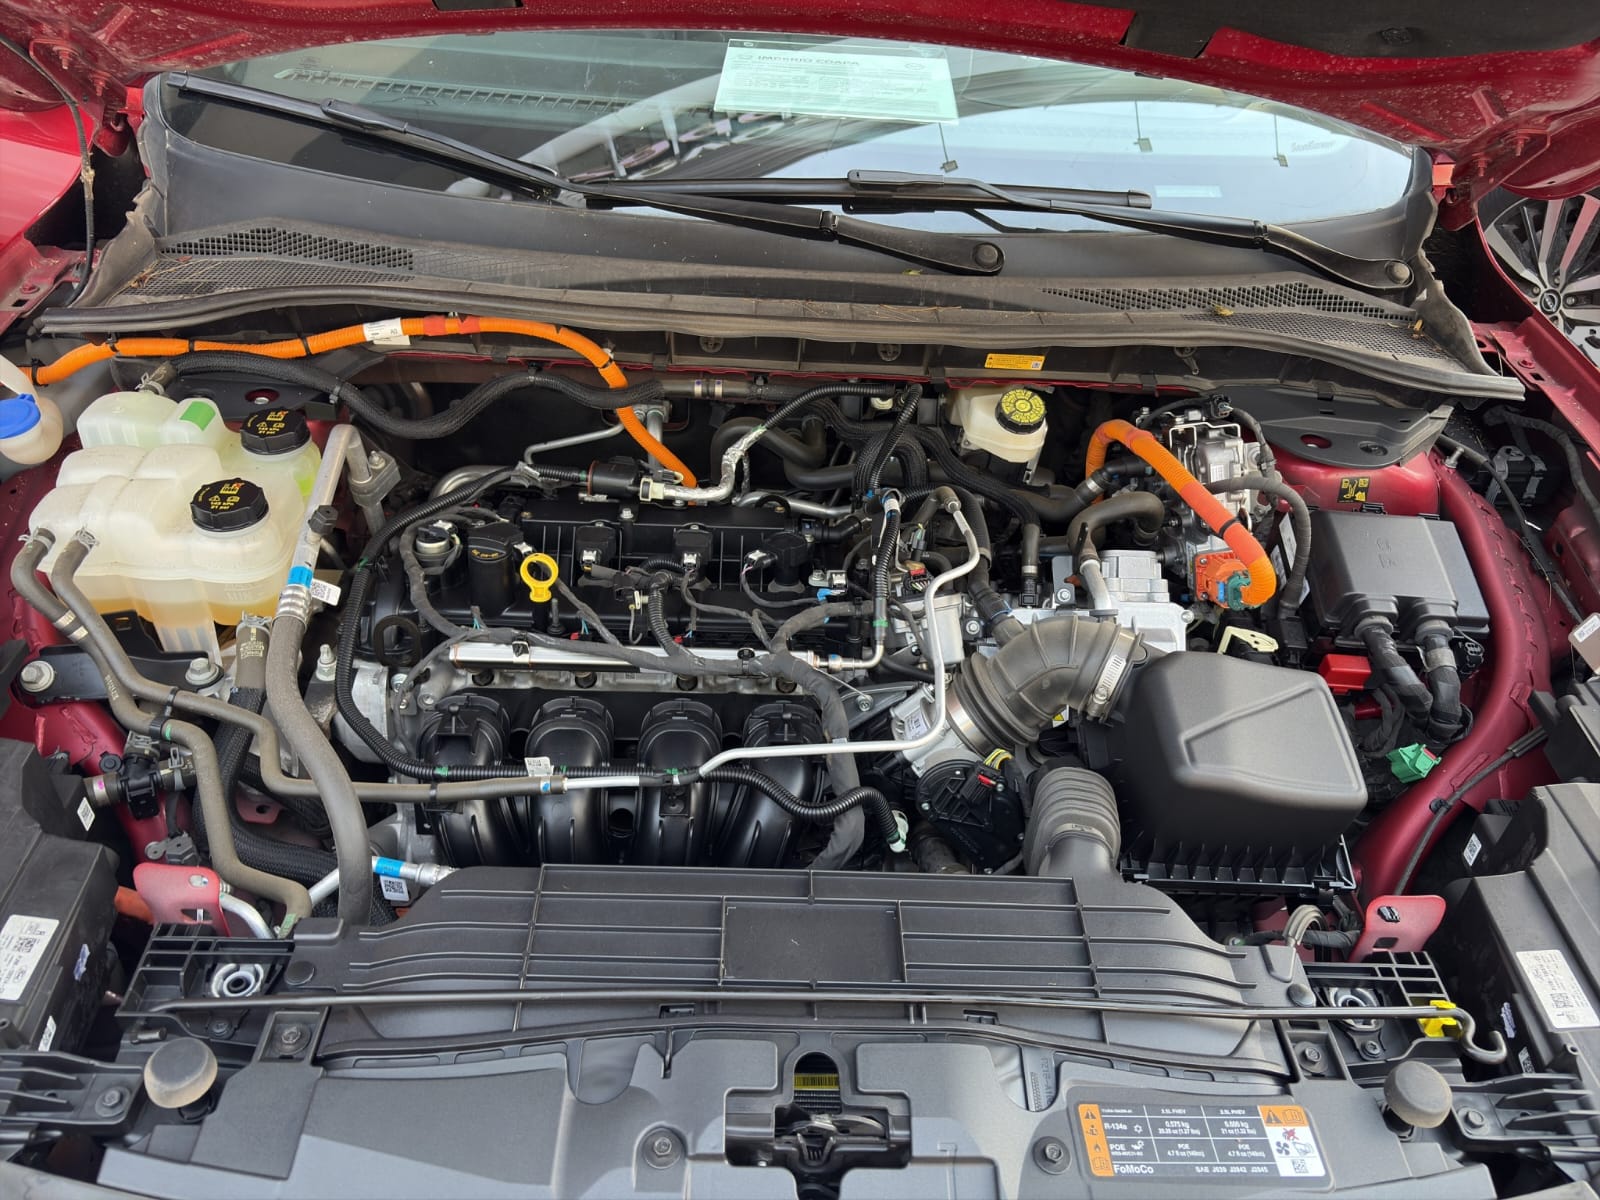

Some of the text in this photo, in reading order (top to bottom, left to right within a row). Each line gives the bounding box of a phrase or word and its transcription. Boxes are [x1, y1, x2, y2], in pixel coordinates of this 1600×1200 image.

[1103, 1122, 1128, 1131] R-134a
[1109, 1143, 1126, 1151] POE
[1114, 1164, 1154, 1174] FoMoCo
